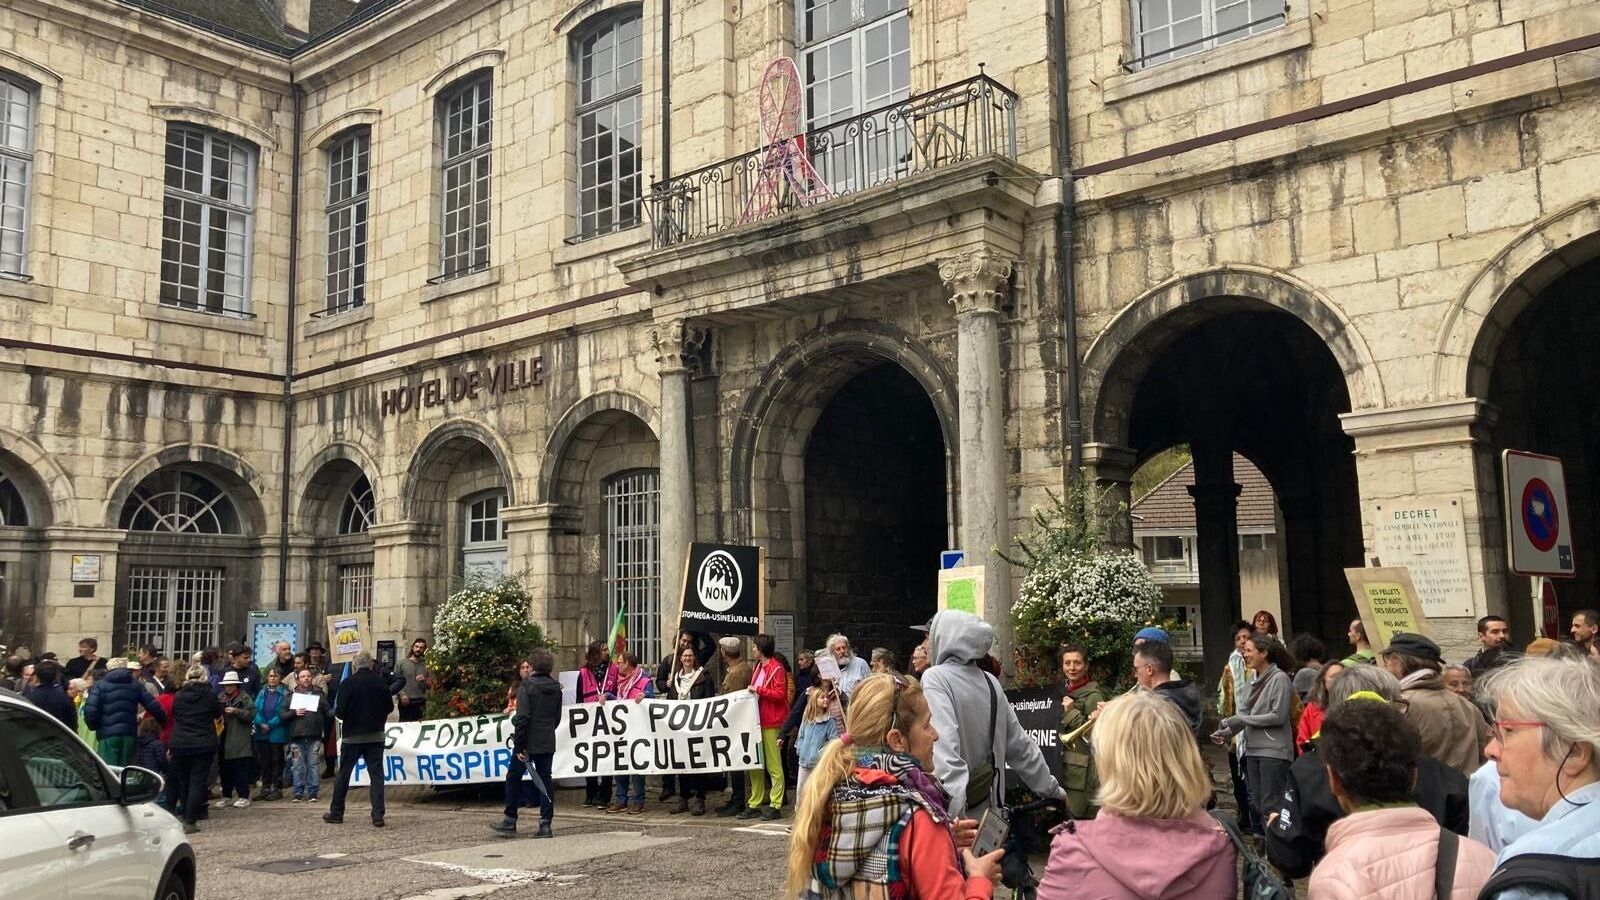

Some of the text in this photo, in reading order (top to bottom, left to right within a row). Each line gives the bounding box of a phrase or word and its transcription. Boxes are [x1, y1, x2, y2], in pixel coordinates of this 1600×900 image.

[451, 370, 478, 403] DE
[485, 356, 543, 395] VILLE
[1394, 508, 1438, 520] DECRET
[705, 586, 728, 602] NON
[1379, 588, 1401, 596] PELLETS
[1383, 620, 1409, 628] PAS AVEC
[568, 698, 729, 739] PAS POUR
